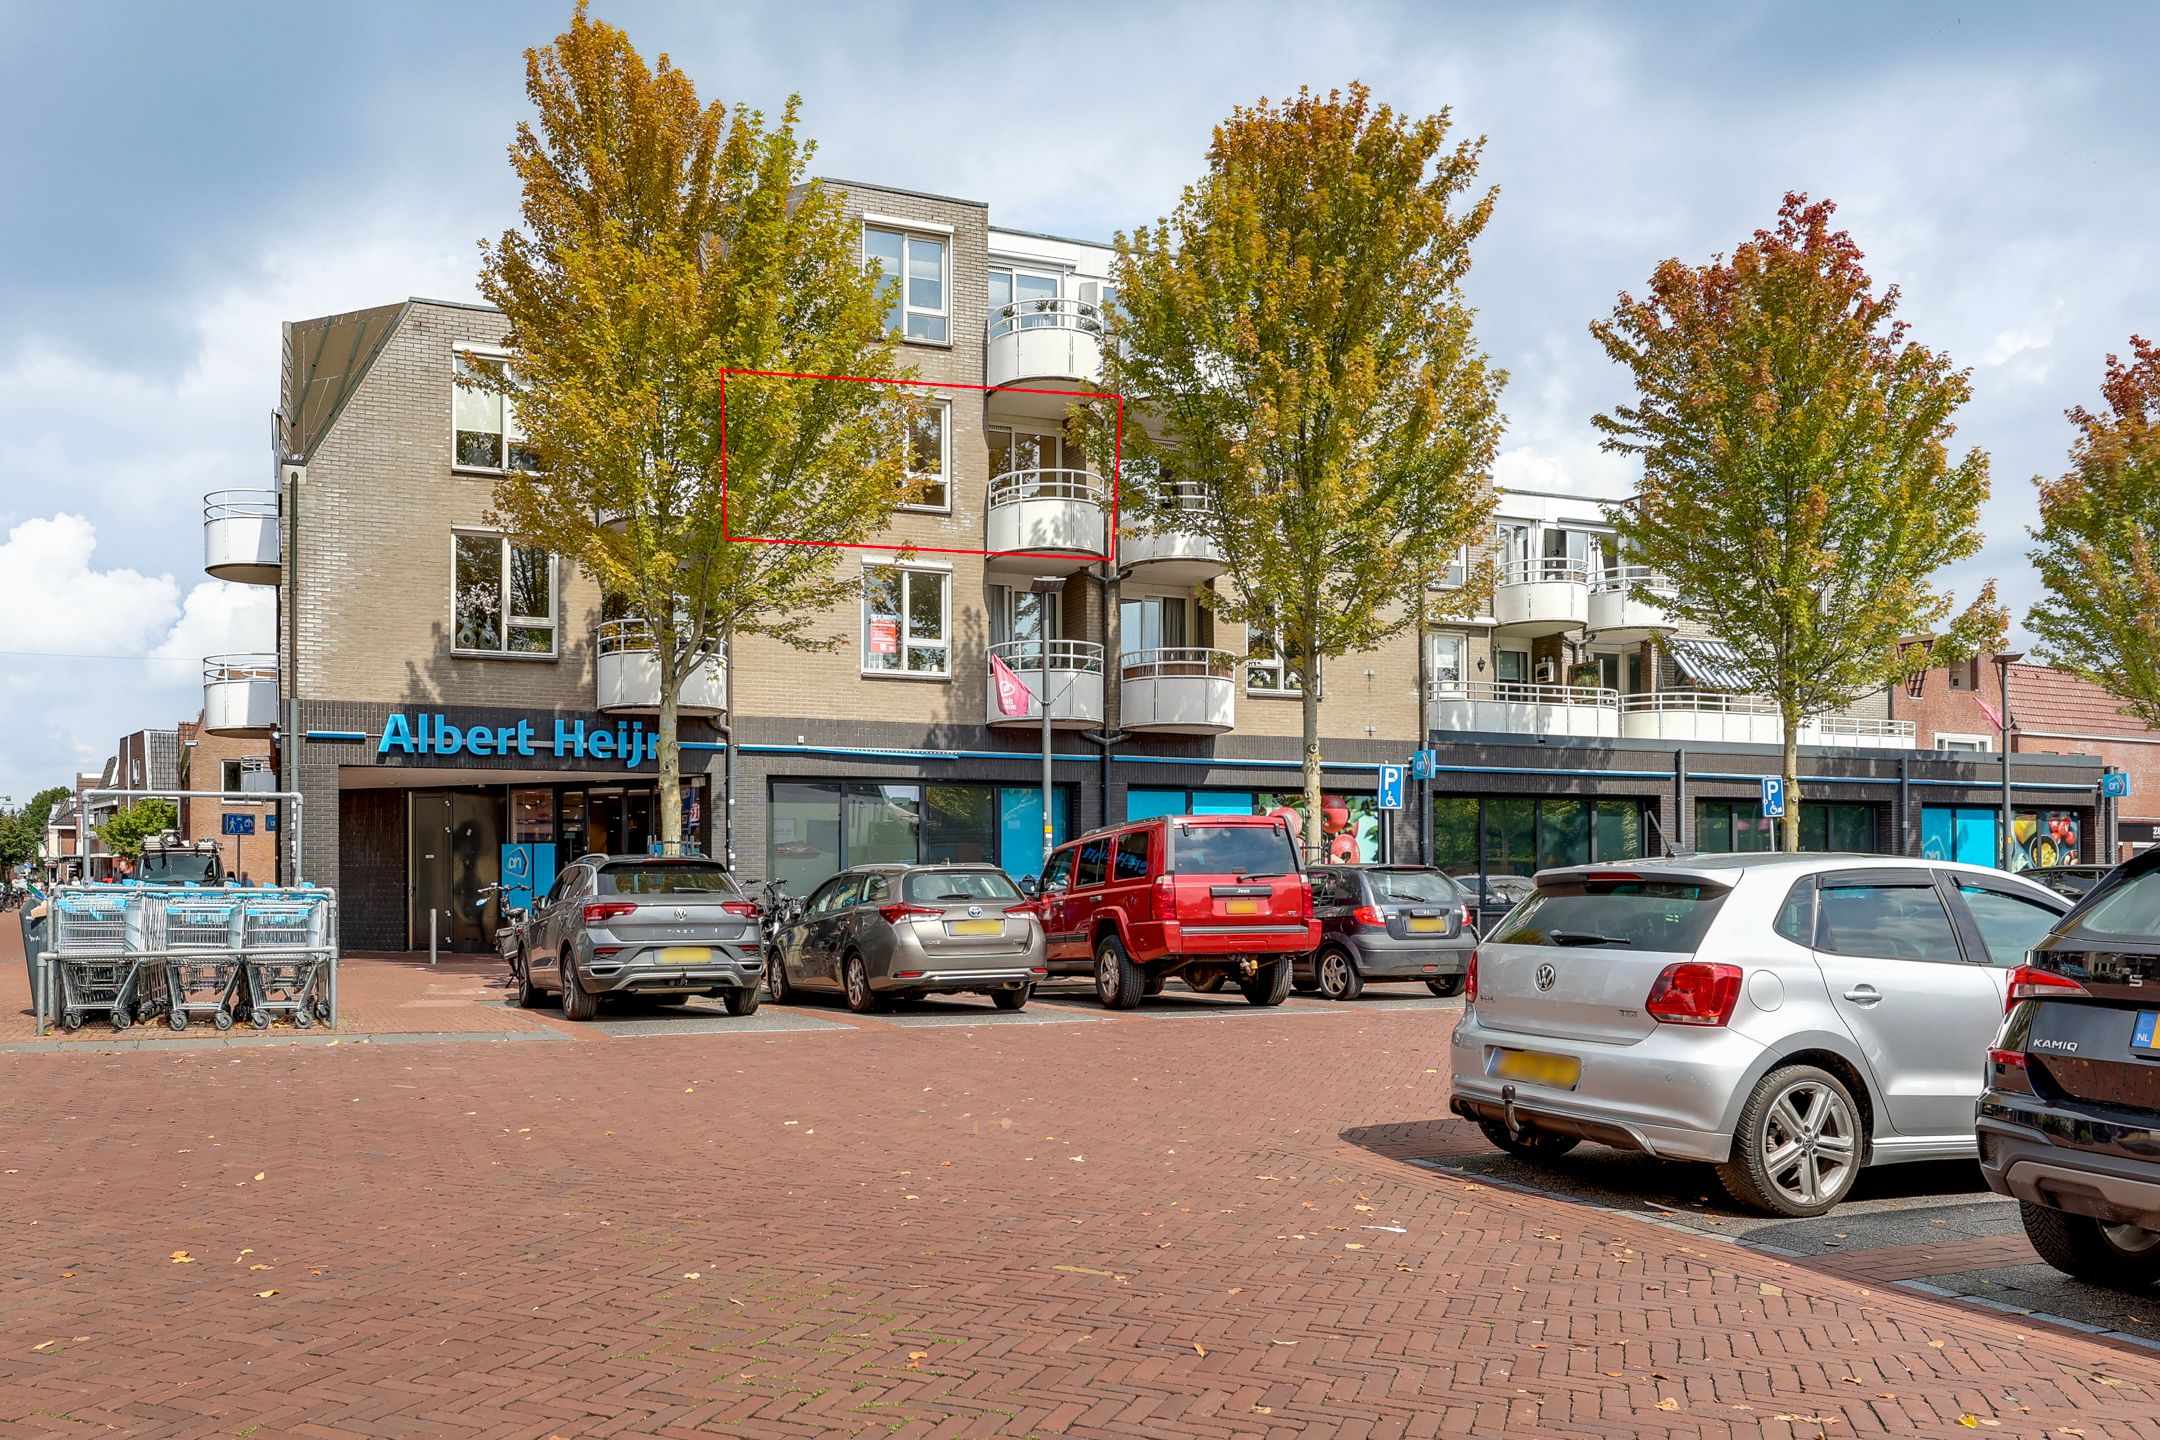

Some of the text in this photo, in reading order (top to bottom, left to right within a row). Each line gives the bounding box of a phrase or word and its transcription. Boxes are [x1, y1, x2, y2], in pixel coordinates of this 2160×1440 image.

[377, 713, 535, 756] Albert
[1384, 768, 1398, 790] P
[1767, 780, 1778, 800] P
[2033, 1038, 2079, 1052] KAMIQ
[2137, 1033, 2150, 1042] NL
